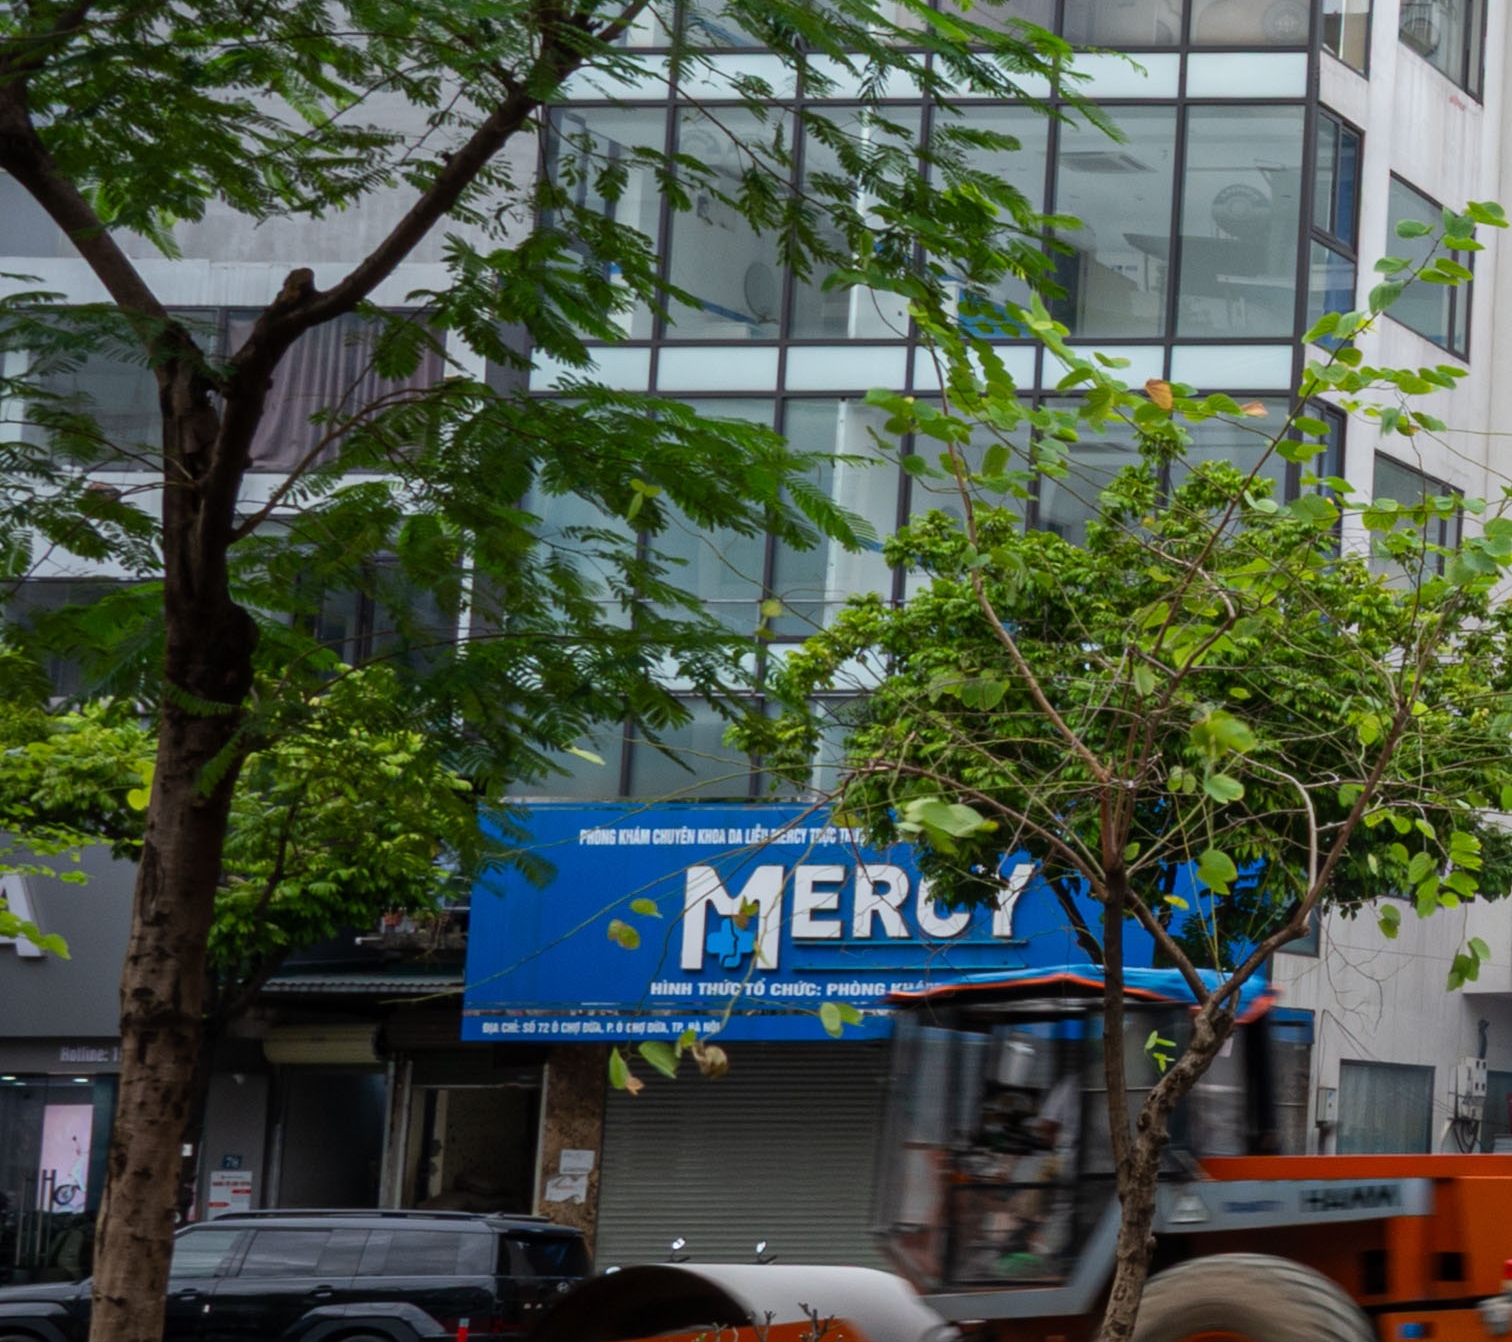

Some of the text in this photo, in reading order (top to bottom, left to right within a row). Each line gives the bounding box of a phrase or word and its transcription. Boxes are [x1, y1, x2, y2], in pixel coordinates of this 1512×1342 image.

[580, 827, 616, 846] PHÒNG
[618, 828, 650, 845] KHÁM
[652, 827, 696, 845] CHUYÊN
[697, 828, 727, 845] KHOA
[728, 829, 744, 845] DA
[681, 864, 1036, 971] MERCY
[650, 979, 693, 996] HÌNH
[698, 978, 742, 996] THỨC
[770, 979, 822, 997] CHỨC:
[826, 980, 886, 997] PHÒNG
[538, 1022, 550, 1034] 72
